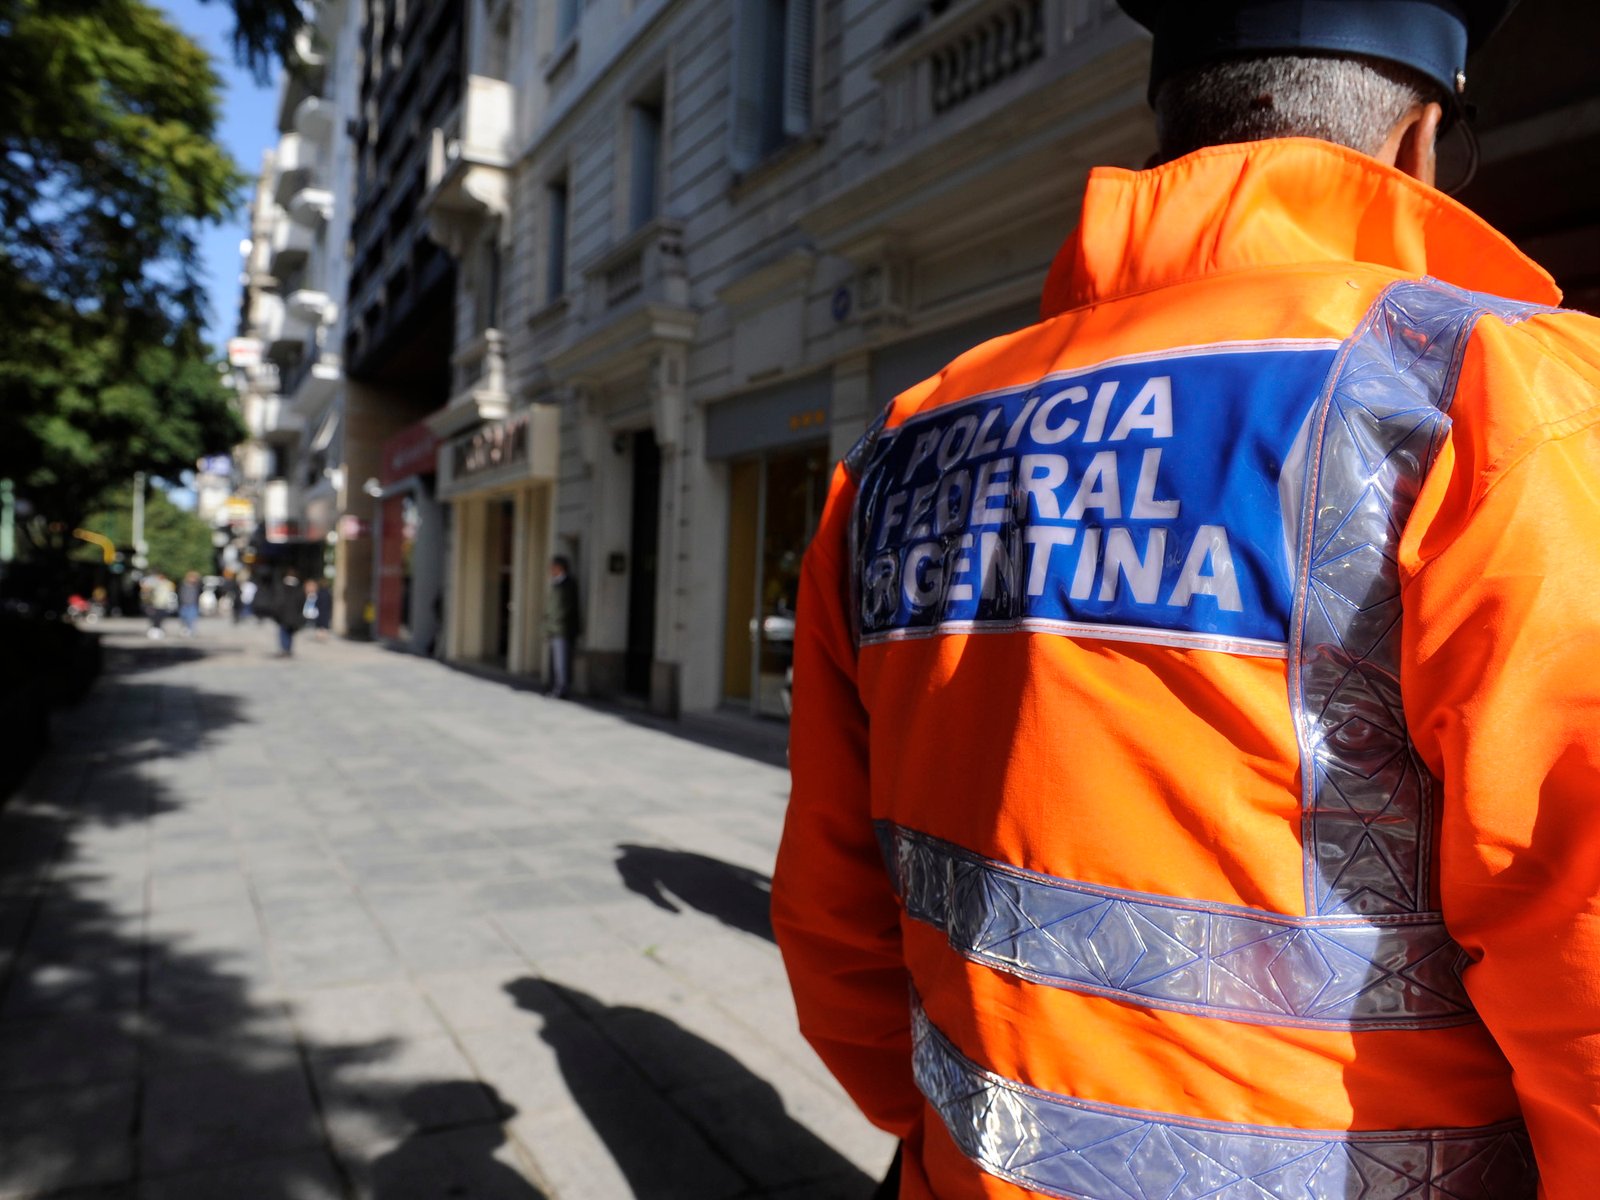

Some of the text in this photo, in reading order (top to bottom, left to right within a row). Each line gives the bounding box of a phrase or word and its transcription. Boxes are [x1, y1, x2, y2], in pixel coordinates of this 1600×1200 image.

[903, 376, 1173, 484] POLICIA
[877, 448, 1181, 551] FEDERAL
[863, 525, 1243, 621] RGENTINA
